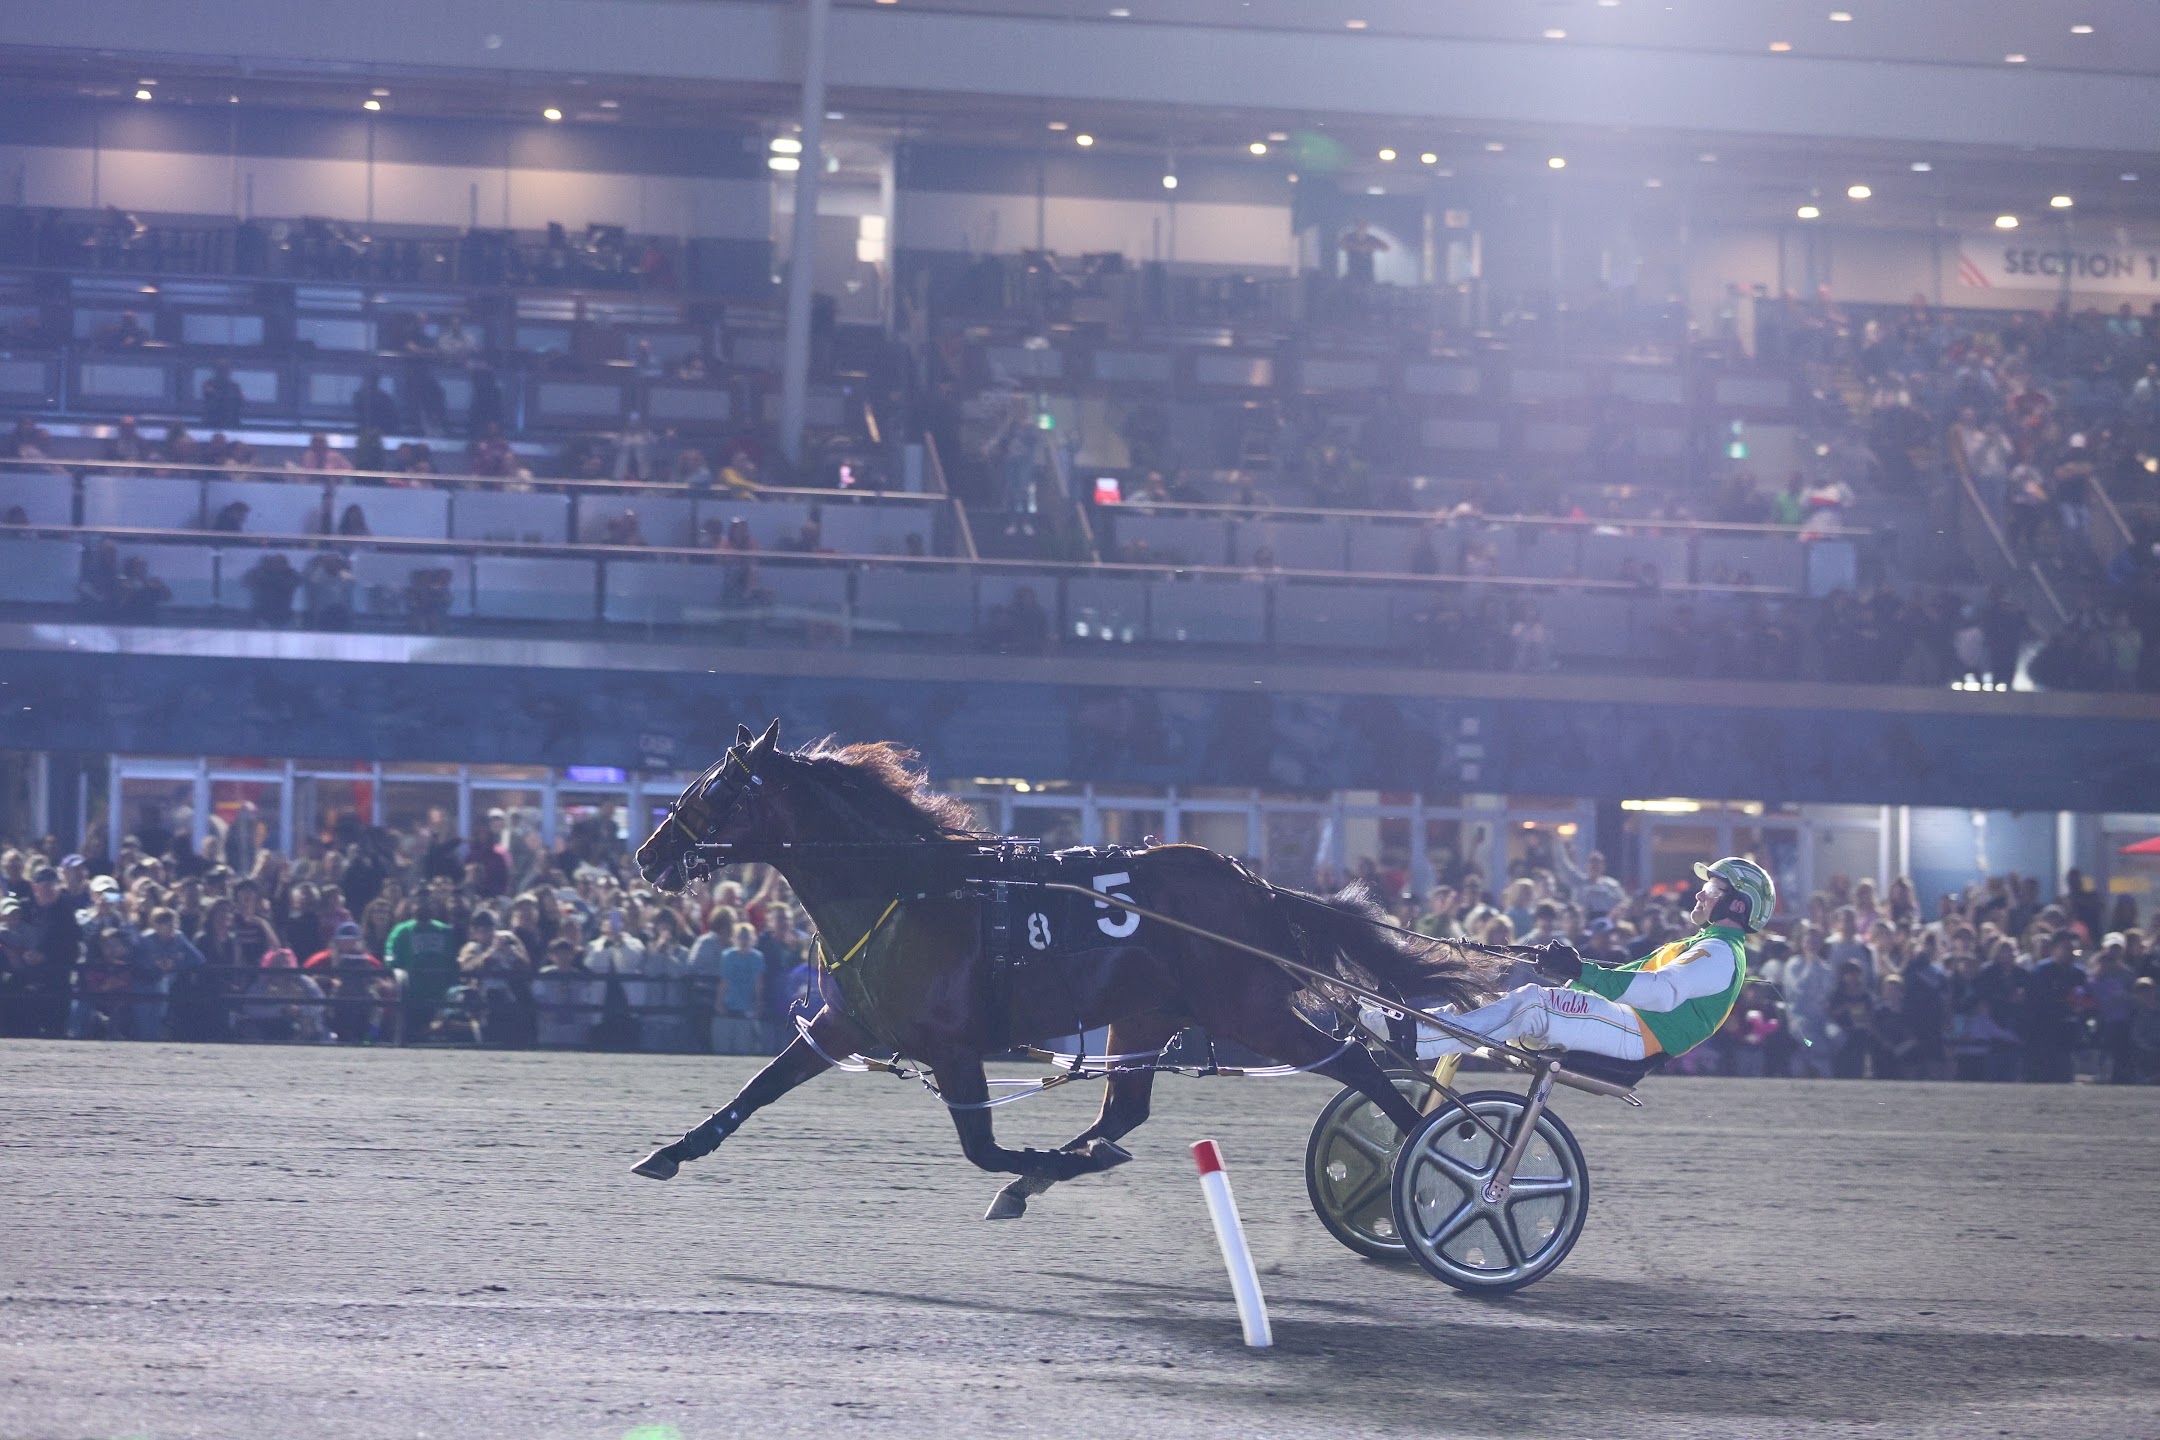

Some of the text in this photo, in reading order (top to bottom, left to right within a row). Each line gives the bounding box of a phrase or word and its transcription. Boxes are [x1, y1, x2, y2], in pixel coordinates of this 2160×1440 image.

[2004, 250, 2135, 278] SECTION
[1092, 871, 1141, 938] 5
[1027, 912, 1051, 950] 8
[1547, 989, 1590, 1013] Walsh
